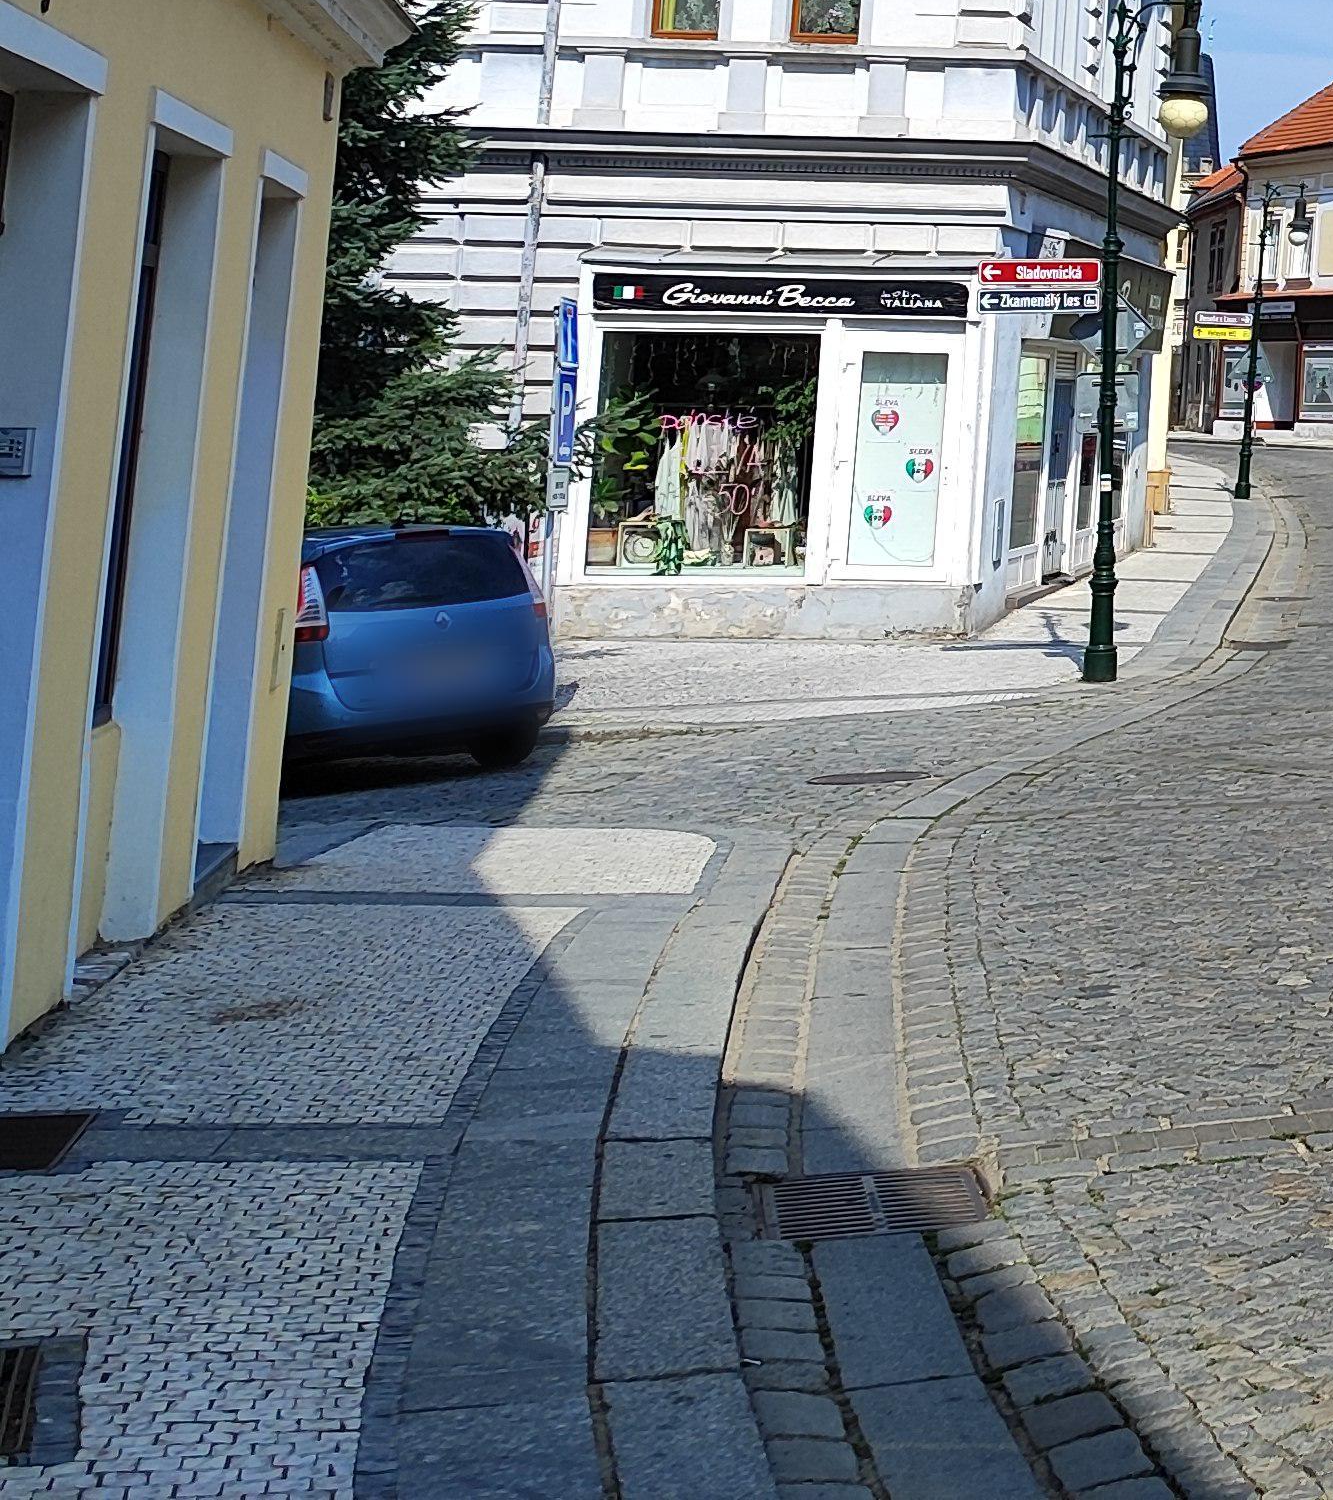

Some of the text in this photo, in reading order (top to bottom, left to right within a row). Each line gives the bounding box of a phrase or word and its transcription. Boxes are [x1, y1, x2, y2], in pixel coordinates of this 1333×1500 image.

[1015, 264, 1083, 280] Sladovnická
[662, 282, 856, 308] Giovanni Becca
[1000, 293, 1081, 311] Zkamenělý les
[559, 382, 574, 437] P
